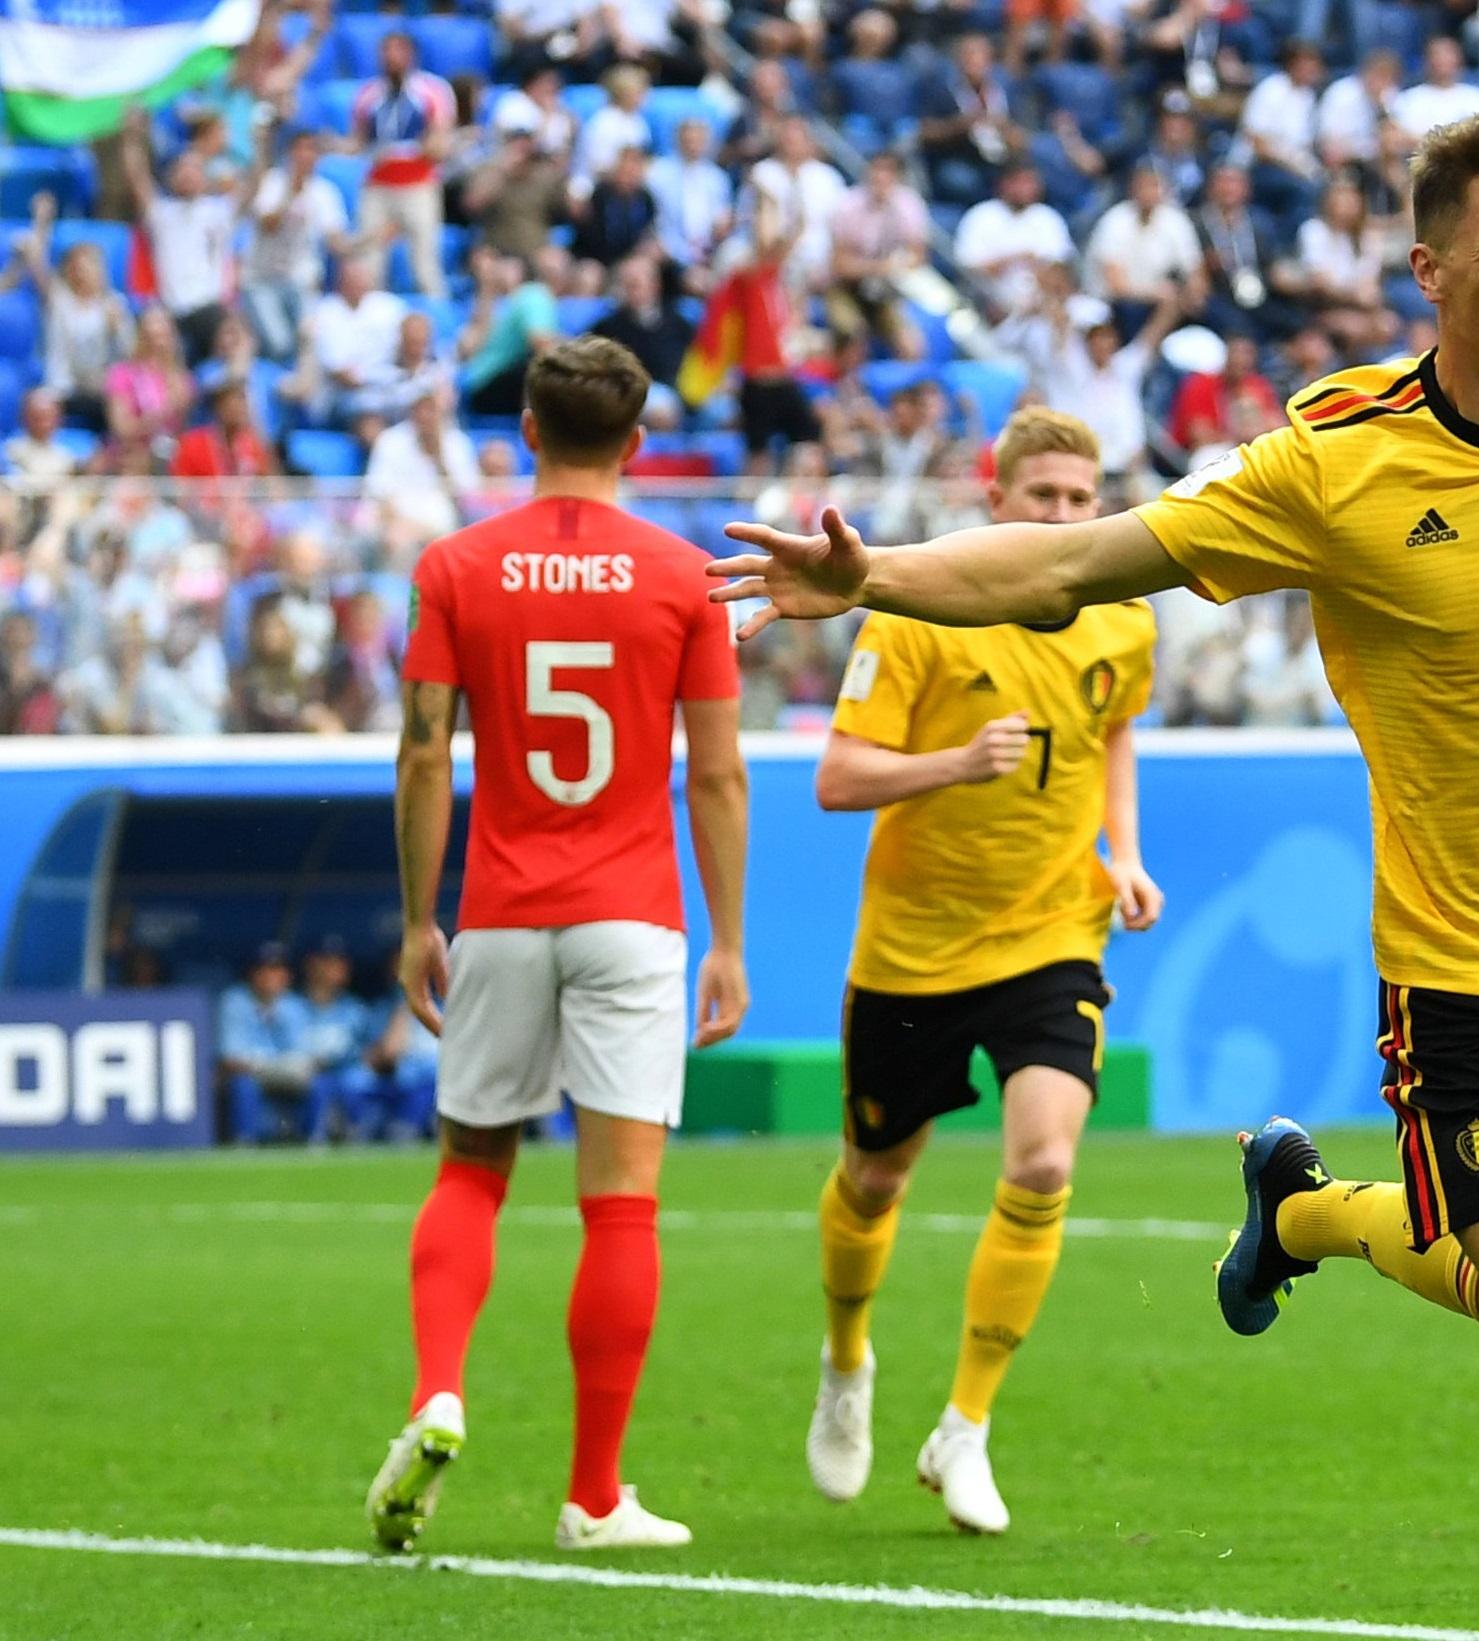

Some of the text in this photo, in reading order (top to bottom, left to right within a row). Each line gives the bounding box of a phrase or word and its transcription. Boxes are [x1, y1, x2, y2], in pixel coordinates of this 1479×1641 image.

[1405, 529, 1460, 548] adidas
[501, 552, 634, 594] STONES
[526, 640, 615, 807] 5
[1025, 727, 1052, 791] 7
